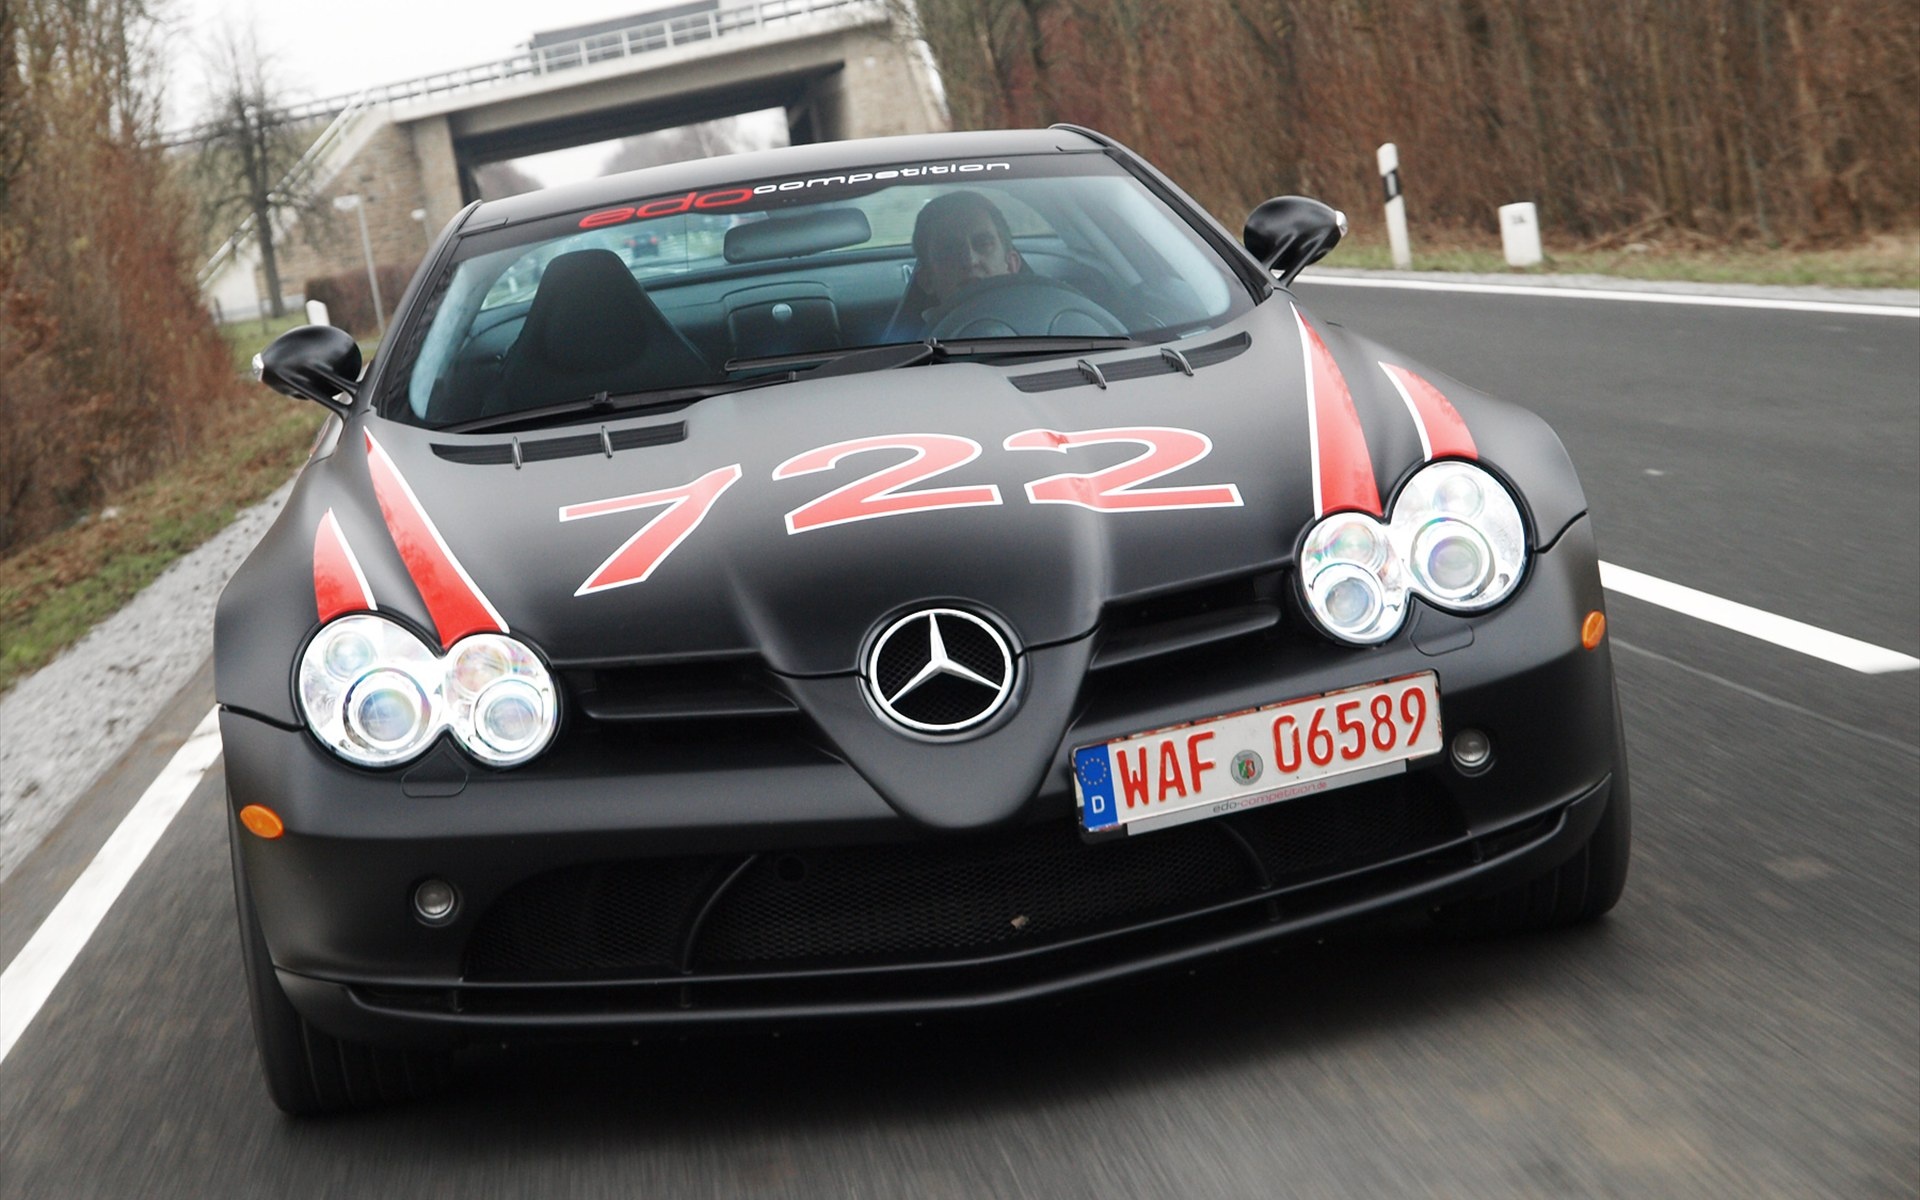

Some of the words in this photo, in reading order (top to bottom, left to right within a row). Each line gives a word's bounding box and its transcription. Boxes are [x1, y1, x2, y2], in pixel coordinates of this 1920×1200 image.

[559, 427, 1244, 596] 722
[1092, 796, 1105, 813] D
[1116, 731, 1216, 808] WAF
[1272, 687, 1426, 774] 06589
